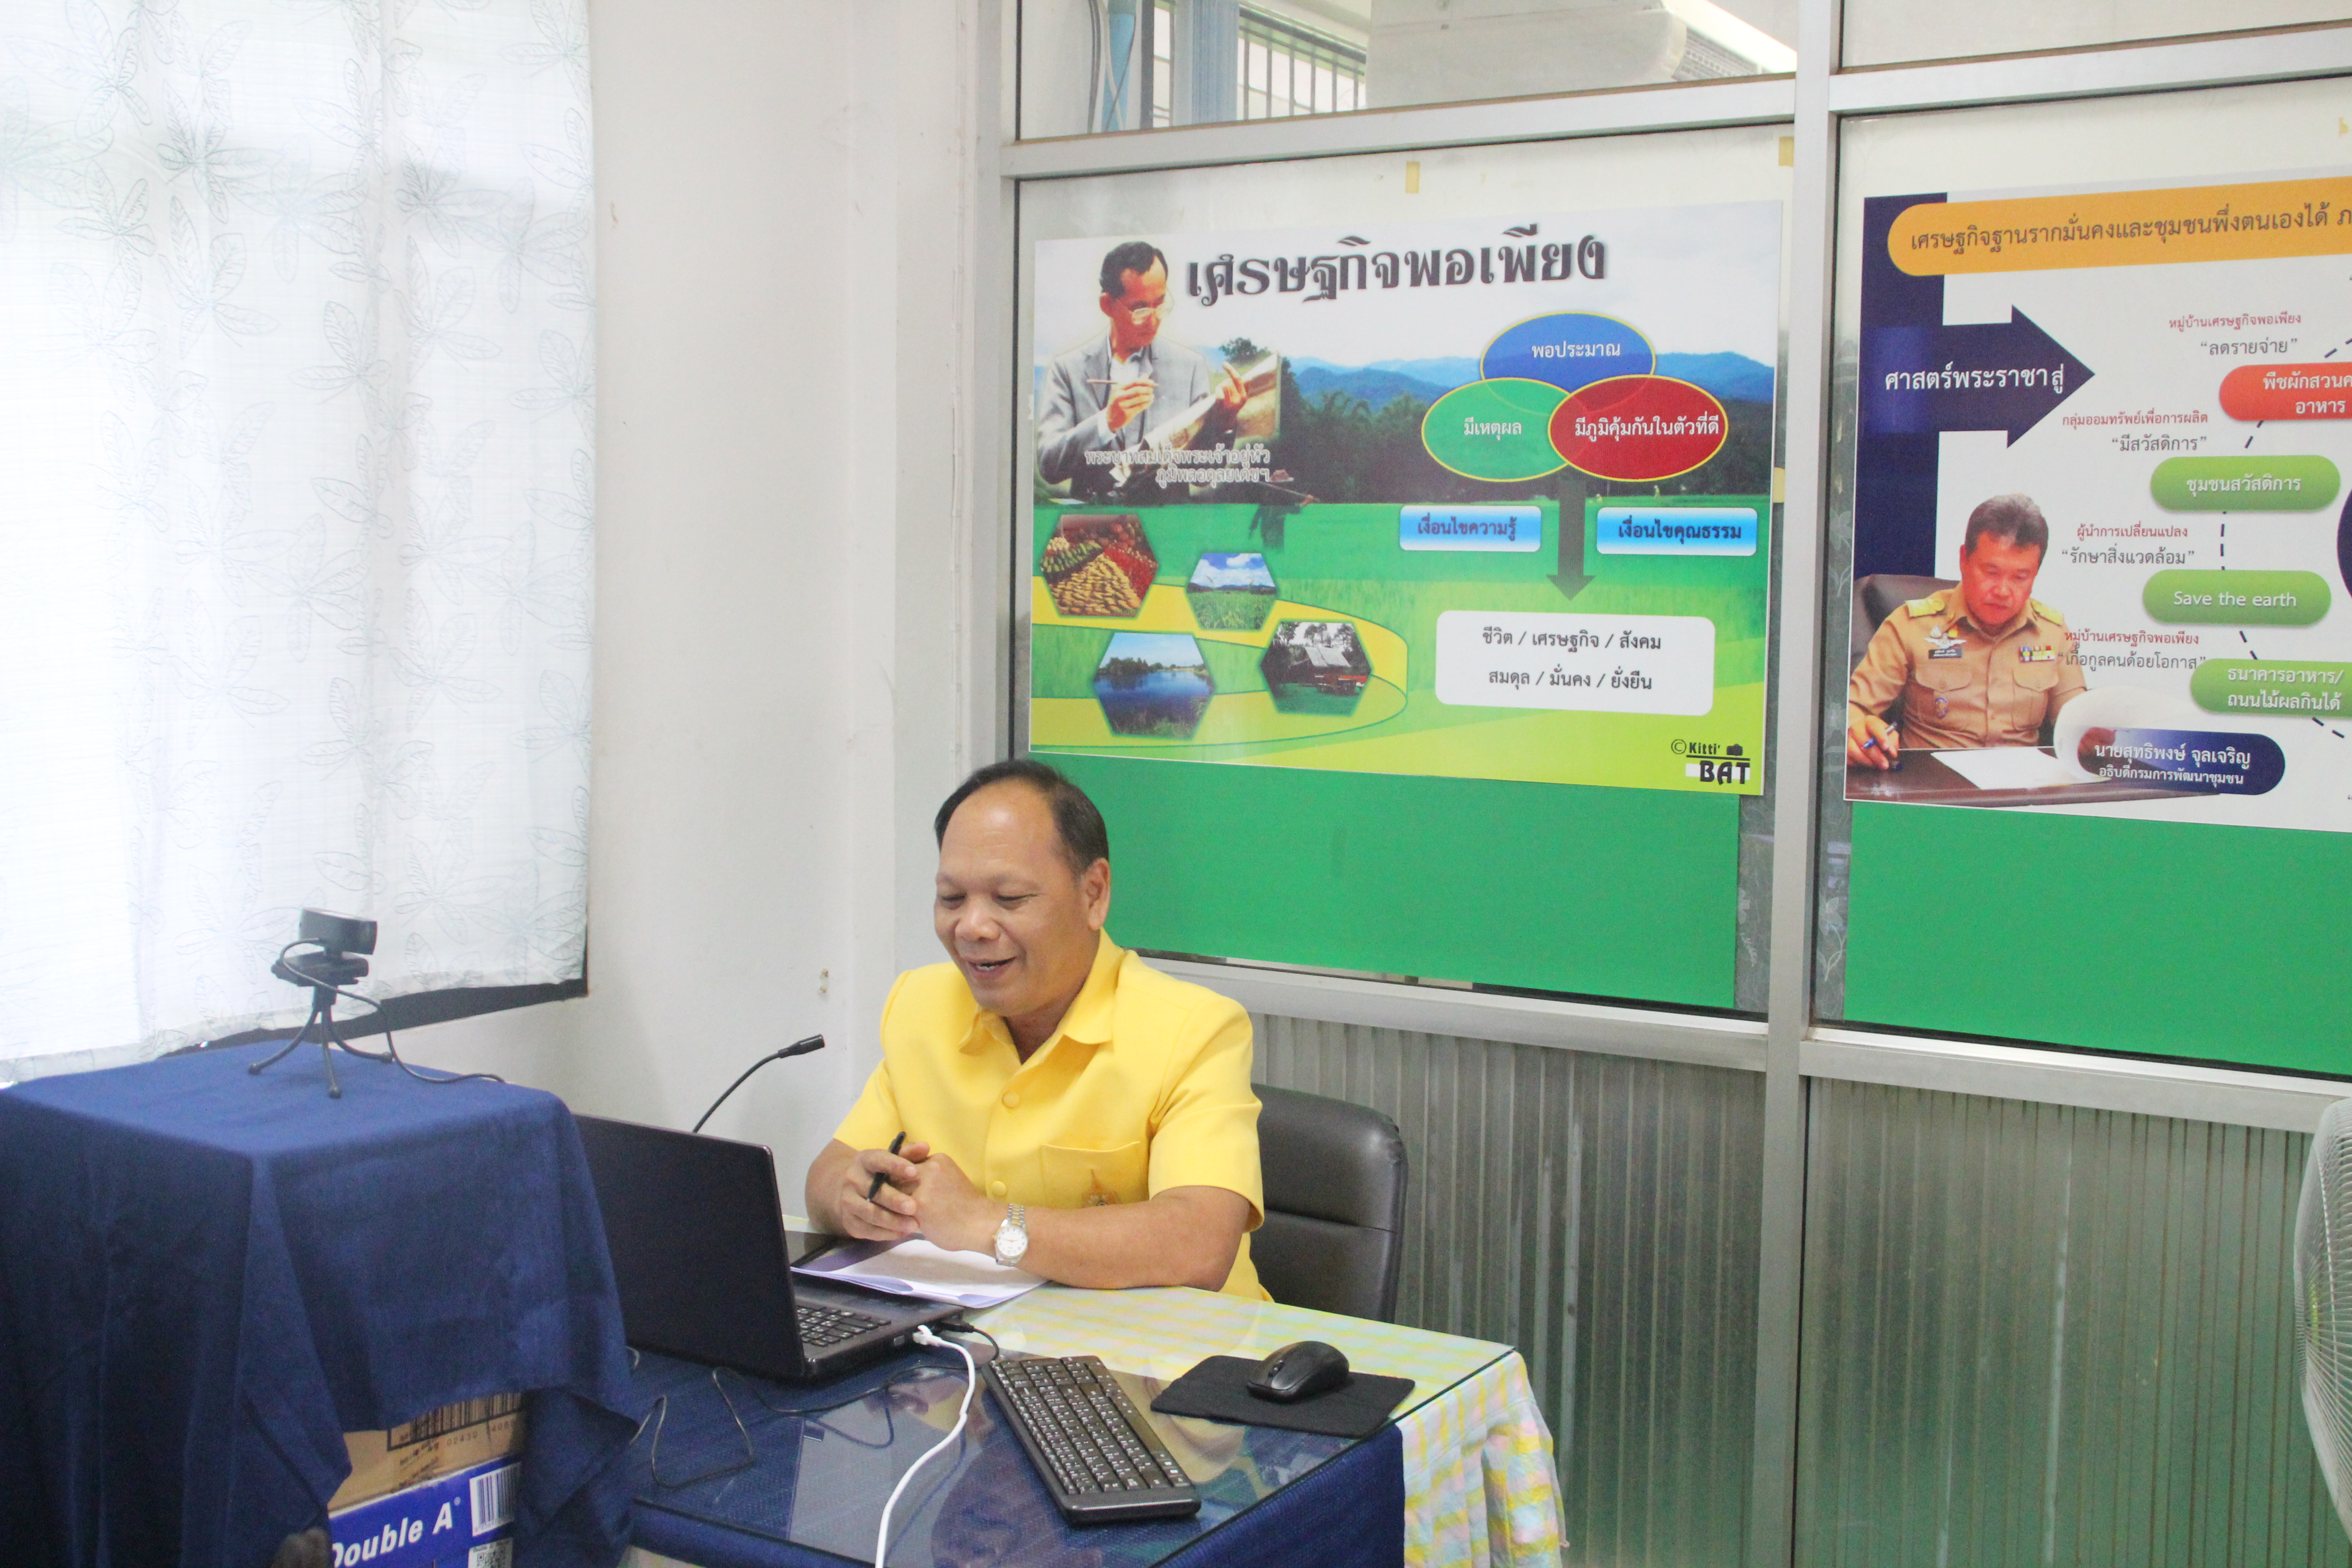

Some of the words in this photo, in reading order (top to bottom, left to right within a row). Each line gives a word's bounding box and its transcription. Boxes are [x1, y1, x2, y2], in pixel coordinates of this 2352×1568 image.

[1911, 201, 2330, 255] เศรษฐกิจฐานรากมั่นคงและชุมชนพึ่งตนเองได้
[1186, 223, 1607, 307] เศรษฐกิจพอเพียง
[2169, 311, 2301, 333] หมู่บ้านเศรษฐกิจพอเพียง
[1531, 341, 1621, 359] พอประมาณ
[2062, 407, 2208, 431] กลุ่มออมทรัพย์เพื่อการผลิต
[2295, 399, 2347, 415] อาหาร
[1463, 416, 1523, 441] มีเหตุผล
[1574, 411, 1720, 442] มีภูมิคุ้มกันในตัวที่ดี
[1084, 442, 1271, 468] พระบาทสมเด็จพระเจ้าอยู่หัว
[2186, 473, 2302, 497] ชุมชนสวัสดิการ
[1417, 512, 1517, 541] เงื่อนไขความรู้
[1618, 515, 1742, 544] เงื่อนไขคุณธรรม
[2077, 520, 2188, 541] ผู้นำการเปลี่ยนแปลง
[2173, 591, 2212, 606] Save
[2218, 591, 2246, 607] the
[2252, 592, 2297, 607] earth
[1482, 626, 1513, 645] ชีวิต
[1518, 631, 1527, 645] /
[1532, 630, 1600, 652] เศรษฐกิจ
[1605, 633, 1614, 648] /
[1619, 630, 1661, 649] สังคม
[2064, 628, 2199, 647] หมู่บ้านเศรษฐกิจพอเพียง
[1489, 670, 1530, 690] สมดุล
[1535, 671, 1545, 686] /
[1549, 663, 1591, 687] มั่นคง
[1596, 673, 1606, 688] /
[1611, 666, 1652, 690] ยั่งยืน
[2228, 689, 2342, 711] ถนนไม้ผลกินได้
[2094, 742, 2187, 764] นายสุทธิพงษ์
[2191, 746, 2251, 770] จุลเจริญ
[1700, 760, 1750, 786] BAT
[2099, 764, 2245, 788] อธิบดีกรมการพัฒนาชุมชน
[431, 1501, 453, 1535] A
